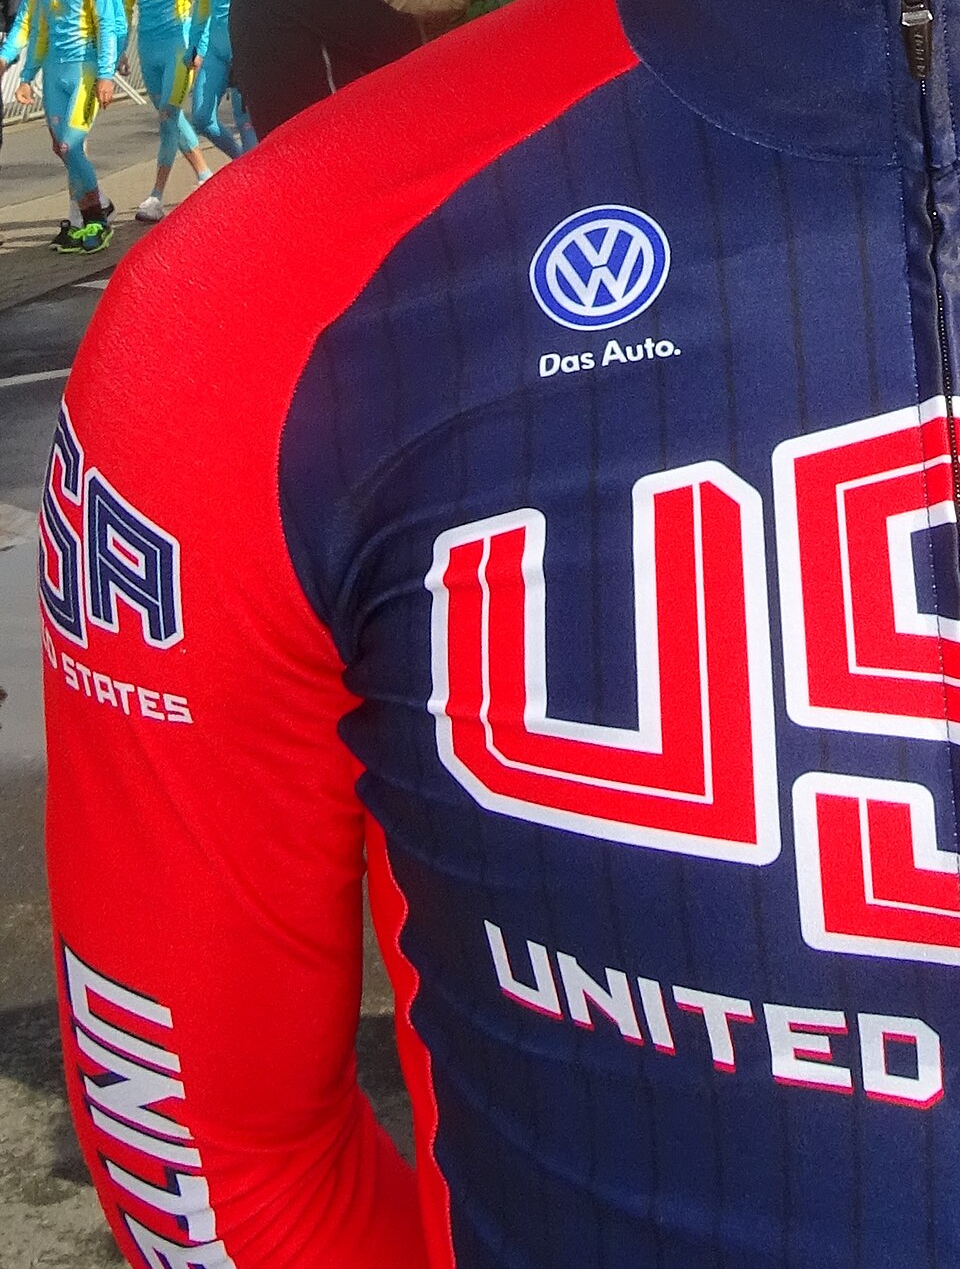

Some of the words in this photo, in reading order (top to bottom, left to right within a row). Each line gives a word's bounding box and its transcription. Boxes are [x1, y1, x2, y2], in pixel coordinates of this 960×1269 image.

[538, 352, 596, 378] Das
[601, 337, 682, 367] Auto.
[61, 652, 194, 724] STATES
[484, 918, 945, 1110] UNITED
